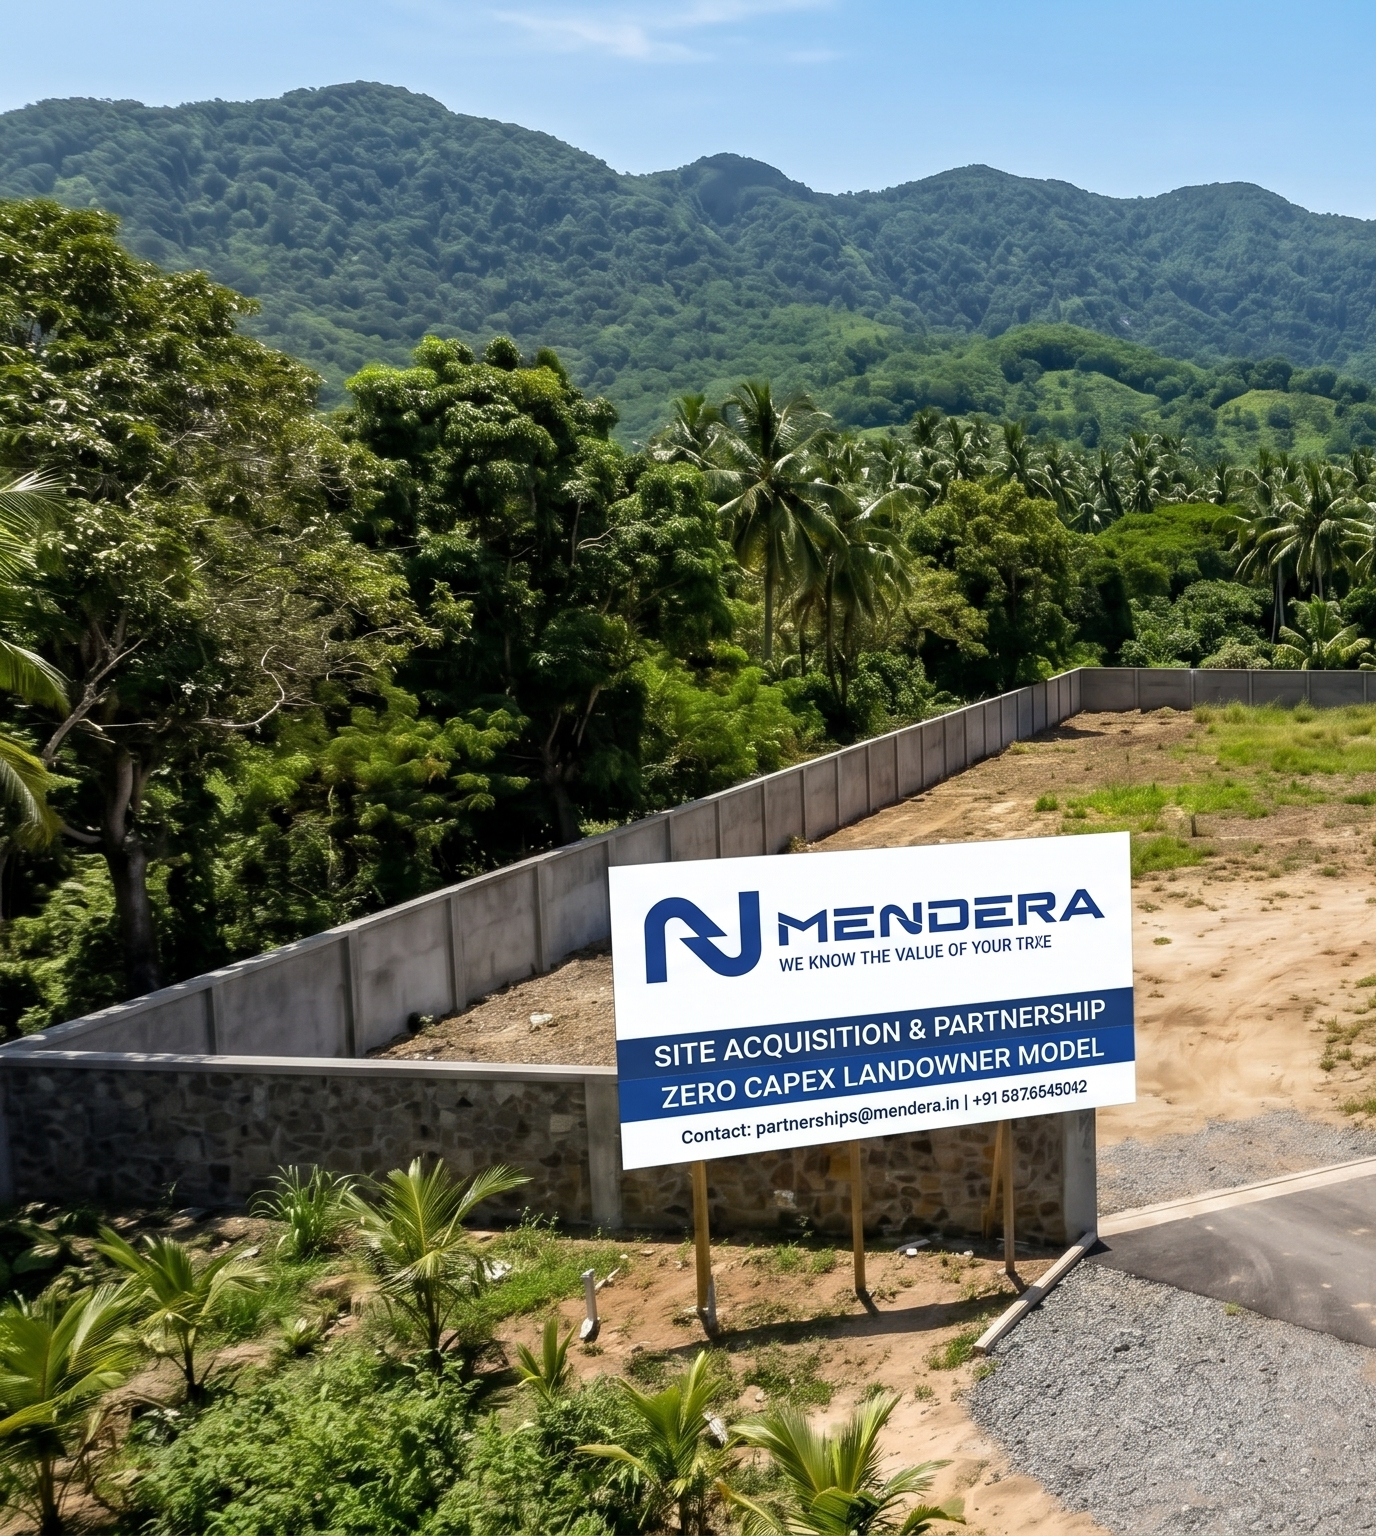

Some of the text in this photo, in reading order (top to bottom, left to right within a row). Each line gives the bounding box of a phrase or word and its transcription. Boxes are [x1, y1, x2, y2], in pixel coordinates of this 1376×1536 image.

[777, 887, 1106, 947] MENDERA
[778, 956, 805, 973] WE
[808, 950, 857, 971] KNOW
[860, 947, 892, 966] THE
[894, 943, 945, 962] VALUE
[948, 941, 968, 957] OF
[971, 937, 1013, 955] YOUR
[654, 999, 1107, 1069] SITE ACQUISITION & PARTNERSHIP
[661, 1037, 1105, 1109] ZERO CAPEX LANDOWNER MODEL
[680, 1123, 752, 1145] Contact:
[756, 1096, 960, 1139] partnerships@mendera.in
[972, 1090, 998, 1106] +91
